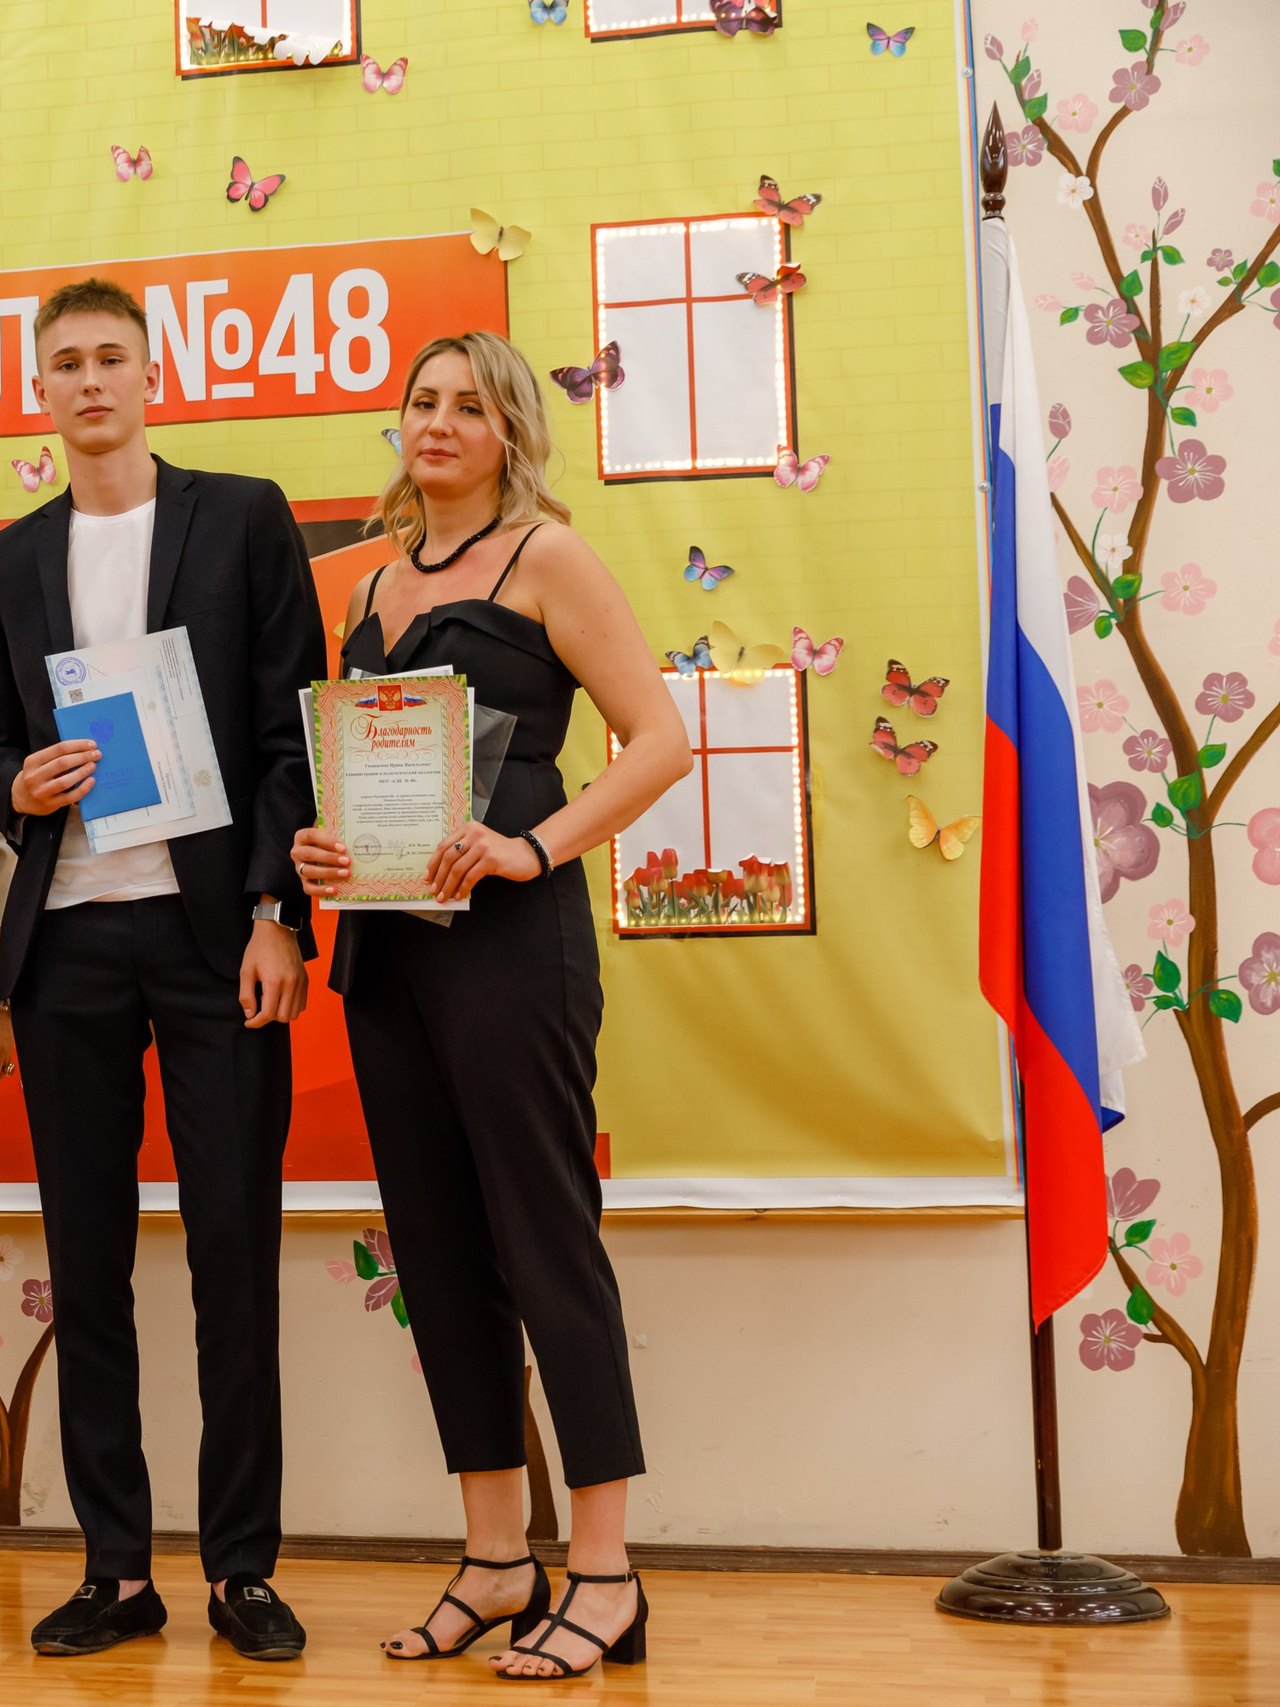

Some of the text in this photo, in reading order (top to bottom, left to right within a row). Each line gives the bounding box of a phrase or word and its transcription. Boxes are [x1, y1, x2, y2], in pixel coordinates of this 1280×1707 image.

[144, 268, 391, 405] №48
[350, 713, 432, 741] Благодарность
[370, 737, 416, 752] родителям
